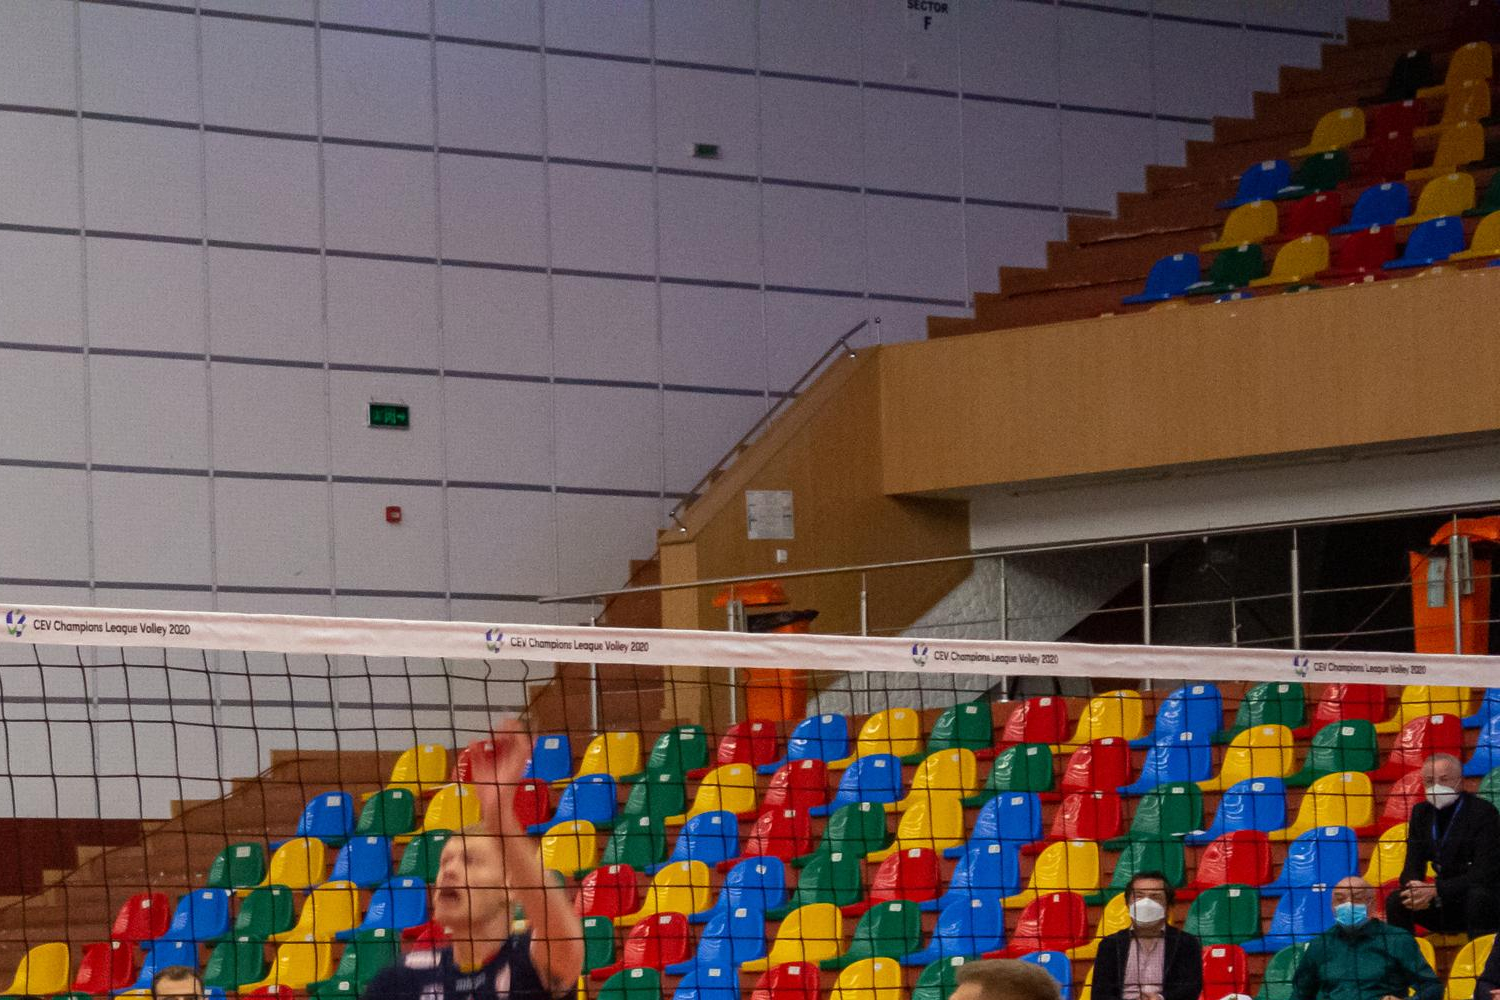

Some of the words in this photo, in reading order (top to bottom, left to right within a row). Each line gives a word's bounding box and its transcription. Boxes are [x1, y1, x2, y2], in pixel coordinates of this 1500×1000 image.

[907, 0, 949, 14] SECTOR
[924, 16, 932, 30] F
[33, 619, 52, 630] CEV
[54, 620, 103, 635] Champions
[105, 622, 137, 635] League
[139, 623, 167, 636] Volley
[169, 624, 191, 635] 2020
[510, 637, 526, 647] CEV
[528, 639, 572, 652] Champions
[574, 640, 603, 652] League
[604, 641, 628, 653] Volley
[631, 642, 649, 652] 2020
[933, 651, 949, 661] CEV
[951, 652, 990, 664] Champions
[992, 653, 1017, 665] League
[1018, 654, 1040, 665] Volley
[1041, 654, 1059, 664] 2020
